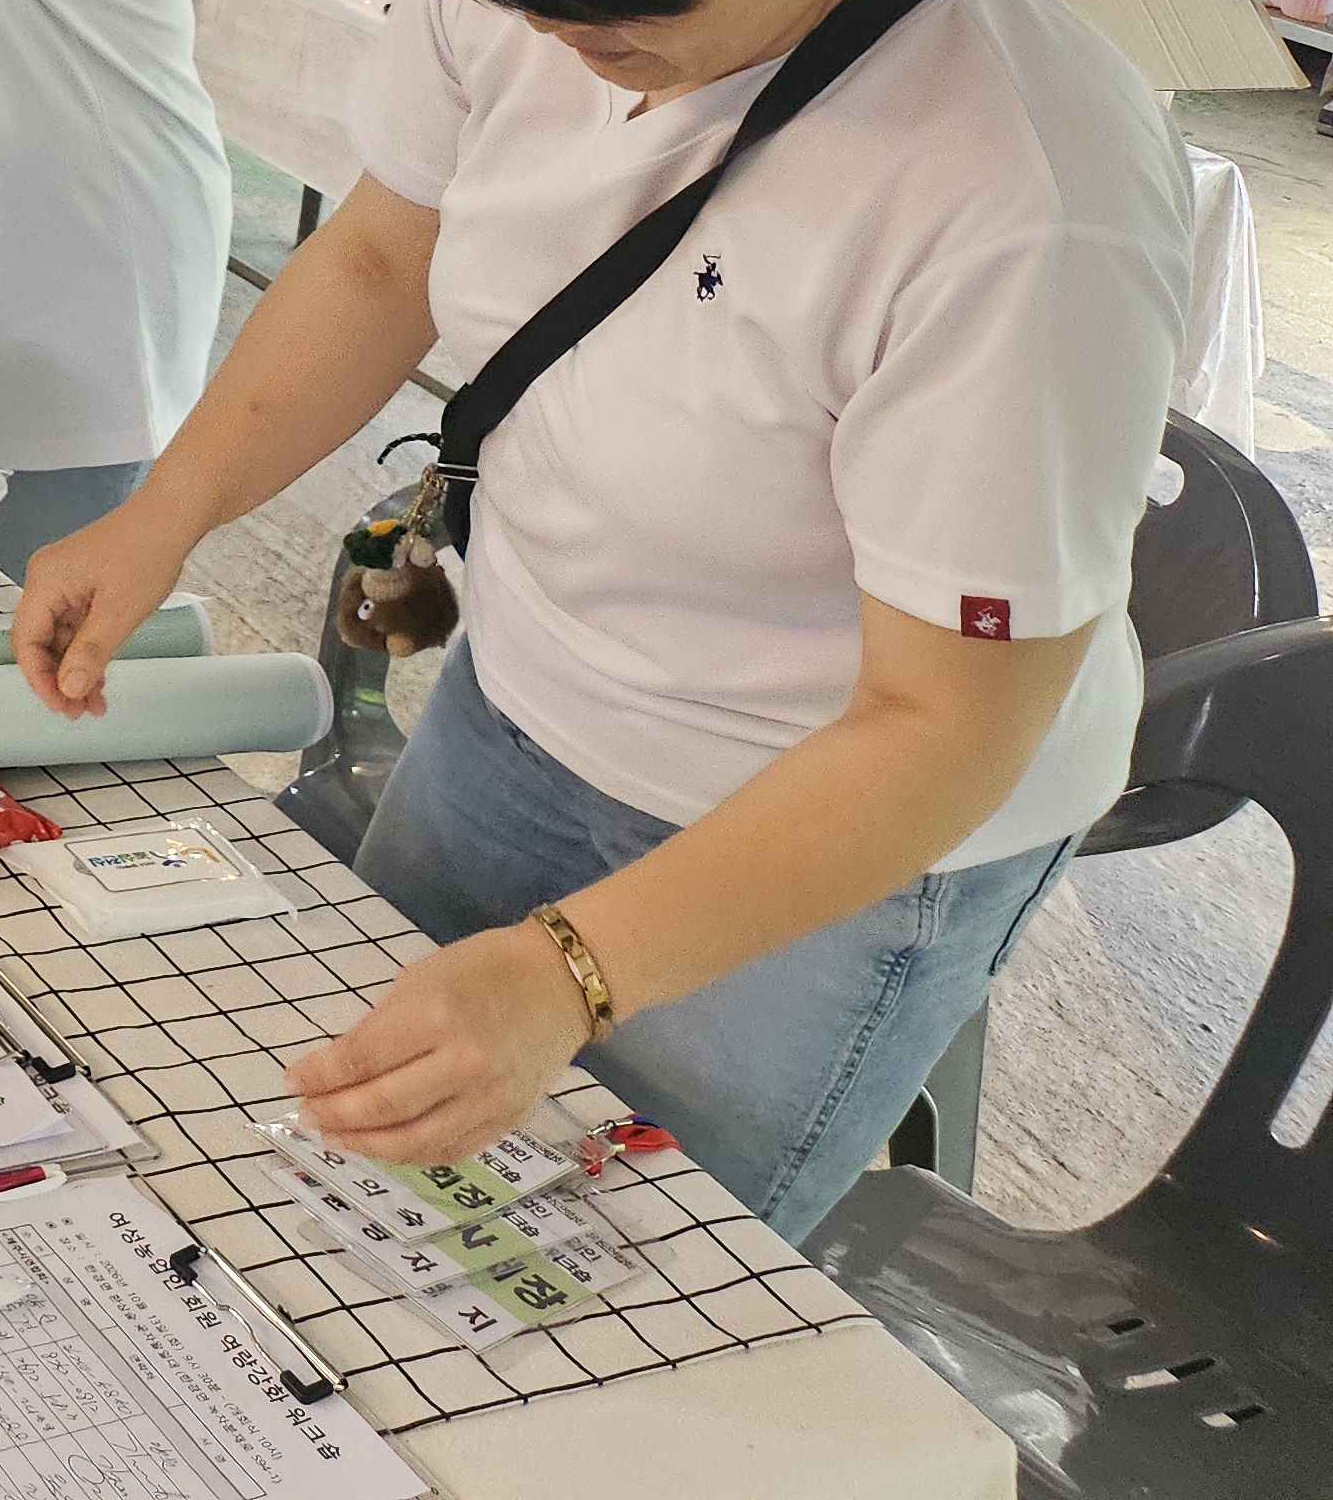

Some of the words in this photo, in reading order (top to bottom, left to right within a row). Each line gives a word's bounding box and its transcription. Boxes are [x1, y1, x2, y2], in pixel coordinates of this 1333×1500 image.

[82, 1264, 113, 1291] 한경면
[108, 1293, 139, 1321] 환상숲
[174, 1370, 210, 1402] (한경면
[249, 1453, 283, 1484] 594-1)
[97, 1259, 129, 1287] 2026년
[125, 1291, 149, 1310] 10월
[145, 1314, 186, 1351] 13일(화)
[196, 1372, 222, 1393] 30분
[222, 1401, 260, 1435] (개회식
[101, 1211, 190, 1291] 여성농업인
[176, 1293, 224, 1329] 회원
[213, 1333, 293, 1404] 역량강화
[280, 1406, 347, 1462] 워크숍
